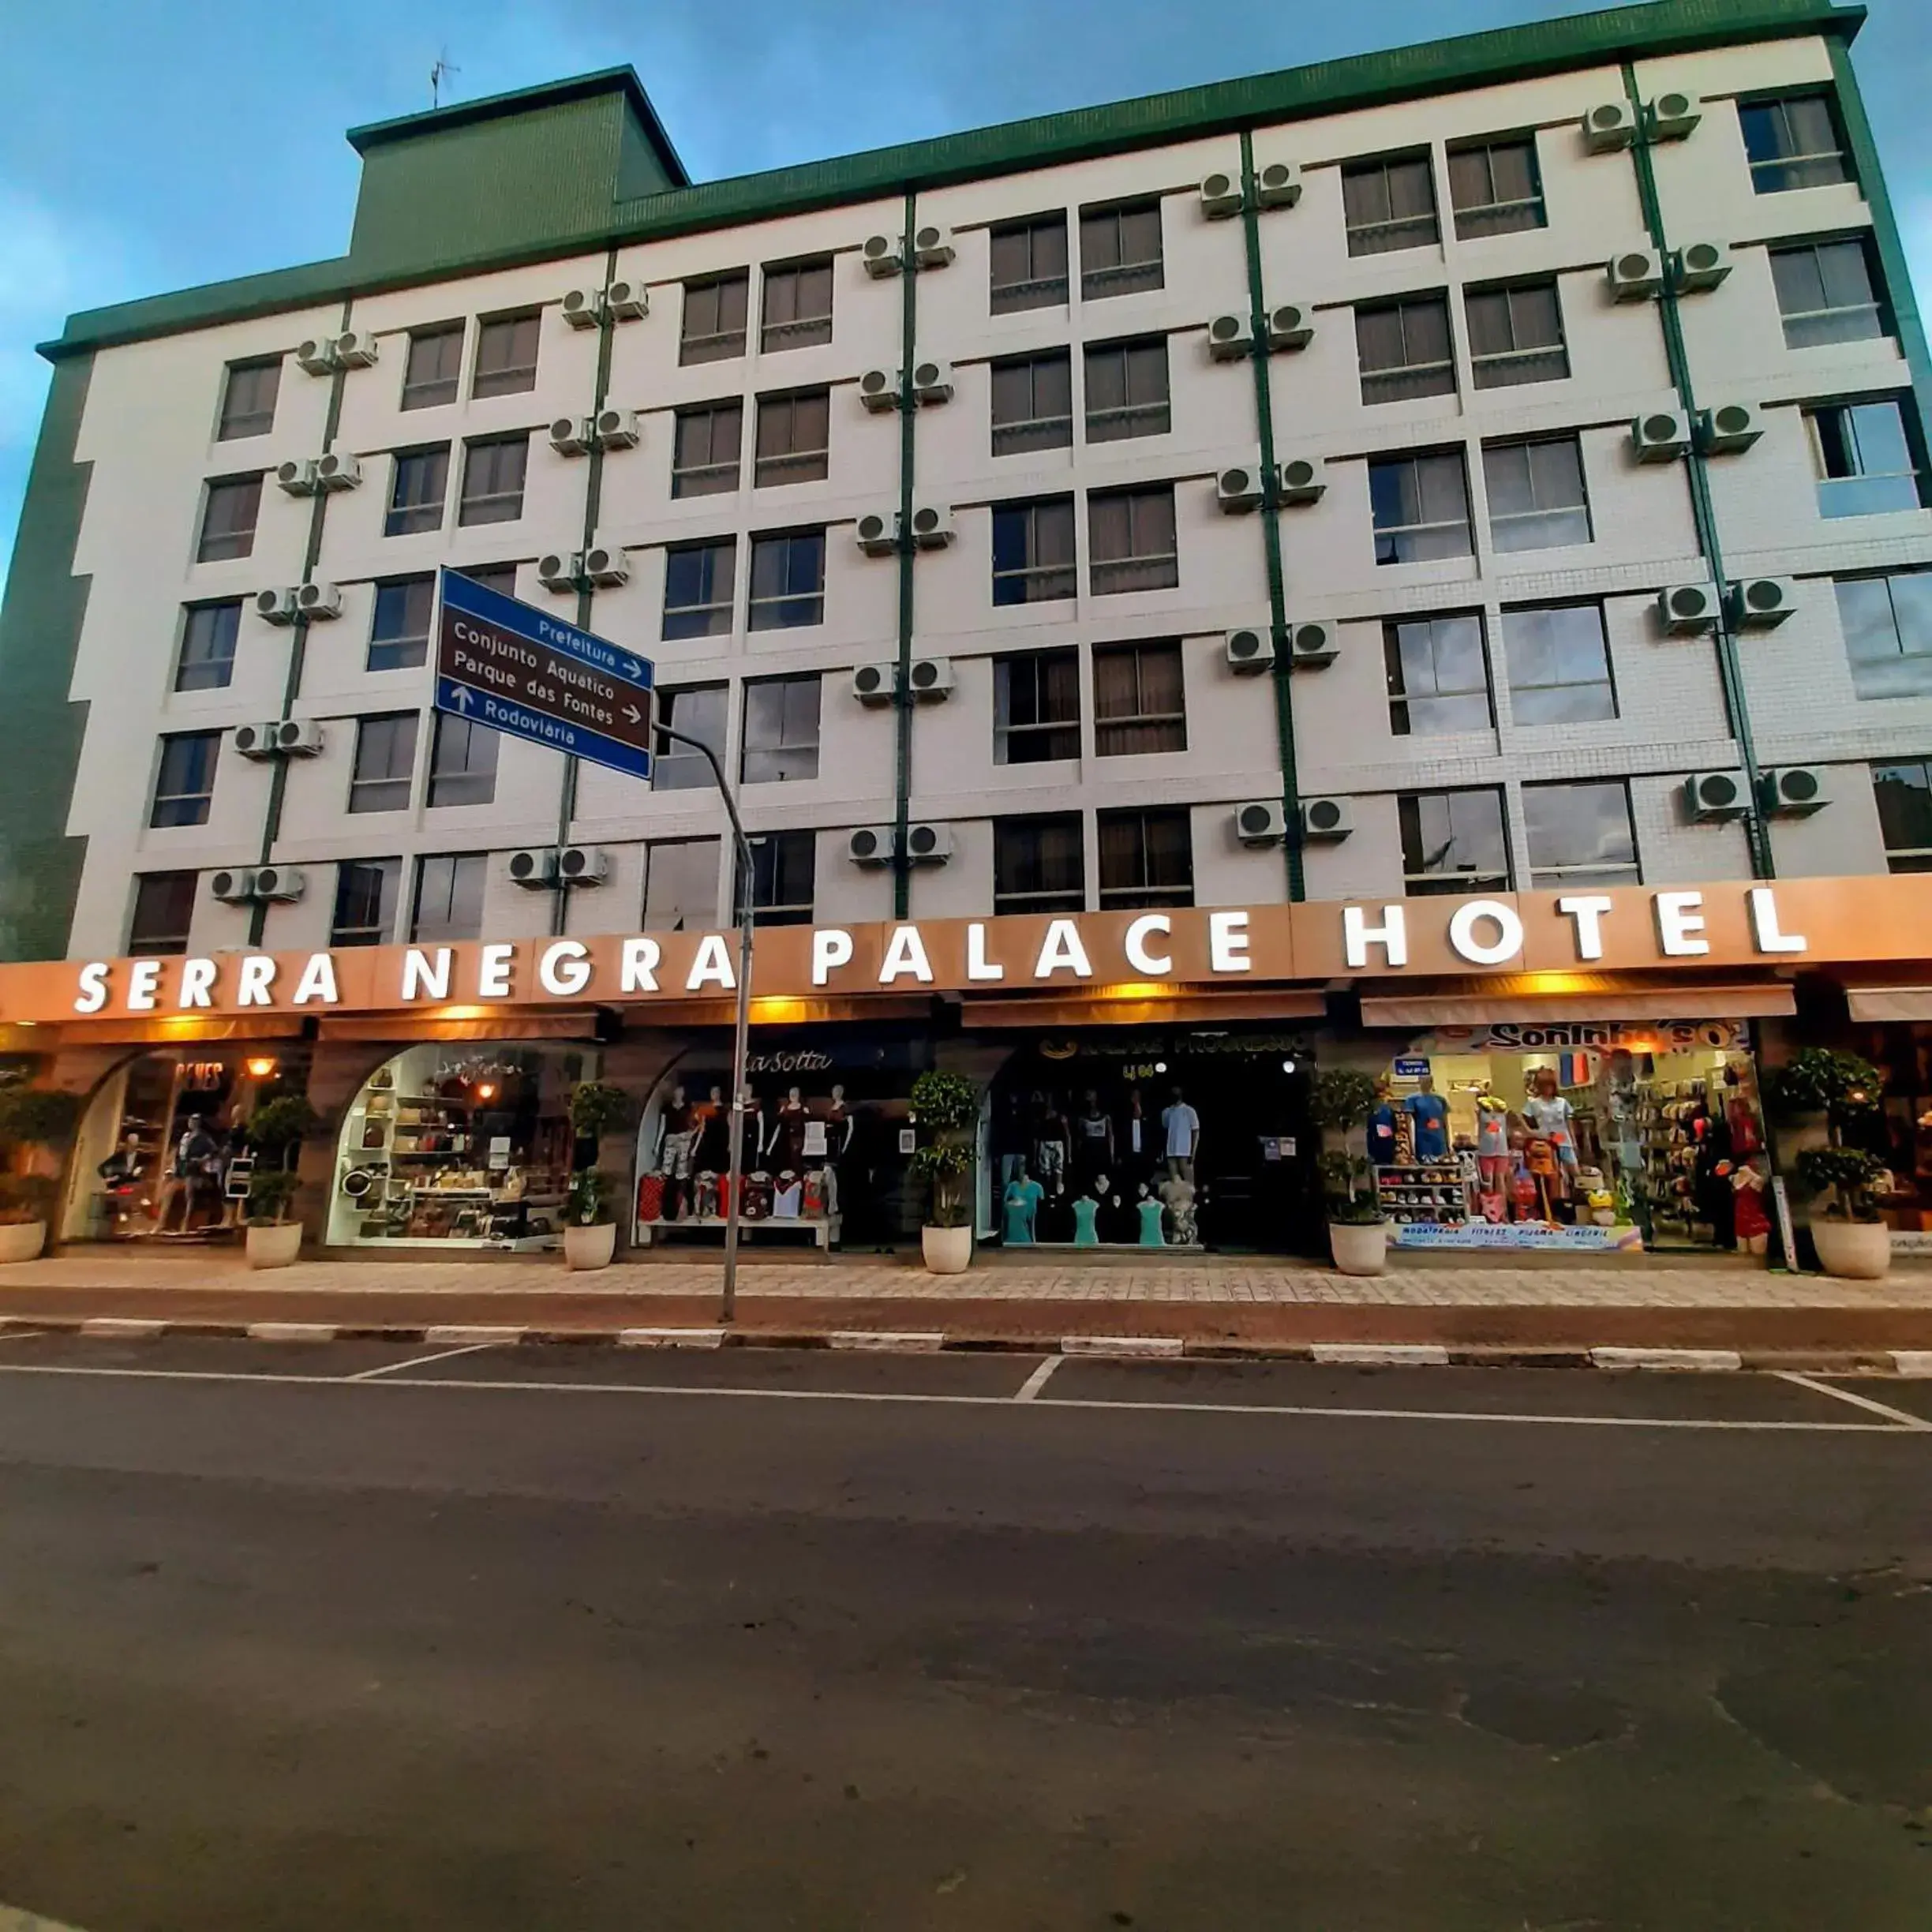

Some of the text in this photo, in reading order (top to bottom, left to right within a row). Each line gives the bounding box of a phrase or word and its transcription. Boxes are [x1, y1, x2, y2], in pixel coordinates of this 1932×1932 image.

[454, 621, 537, 668] Conjunto
[539, 620, 616, 666] Prefeitura
[454, 650, 613, 725] Parque das Fontes
[73, 887, 1807, 1013] SERRA NEGRA PALACE HOTEL
